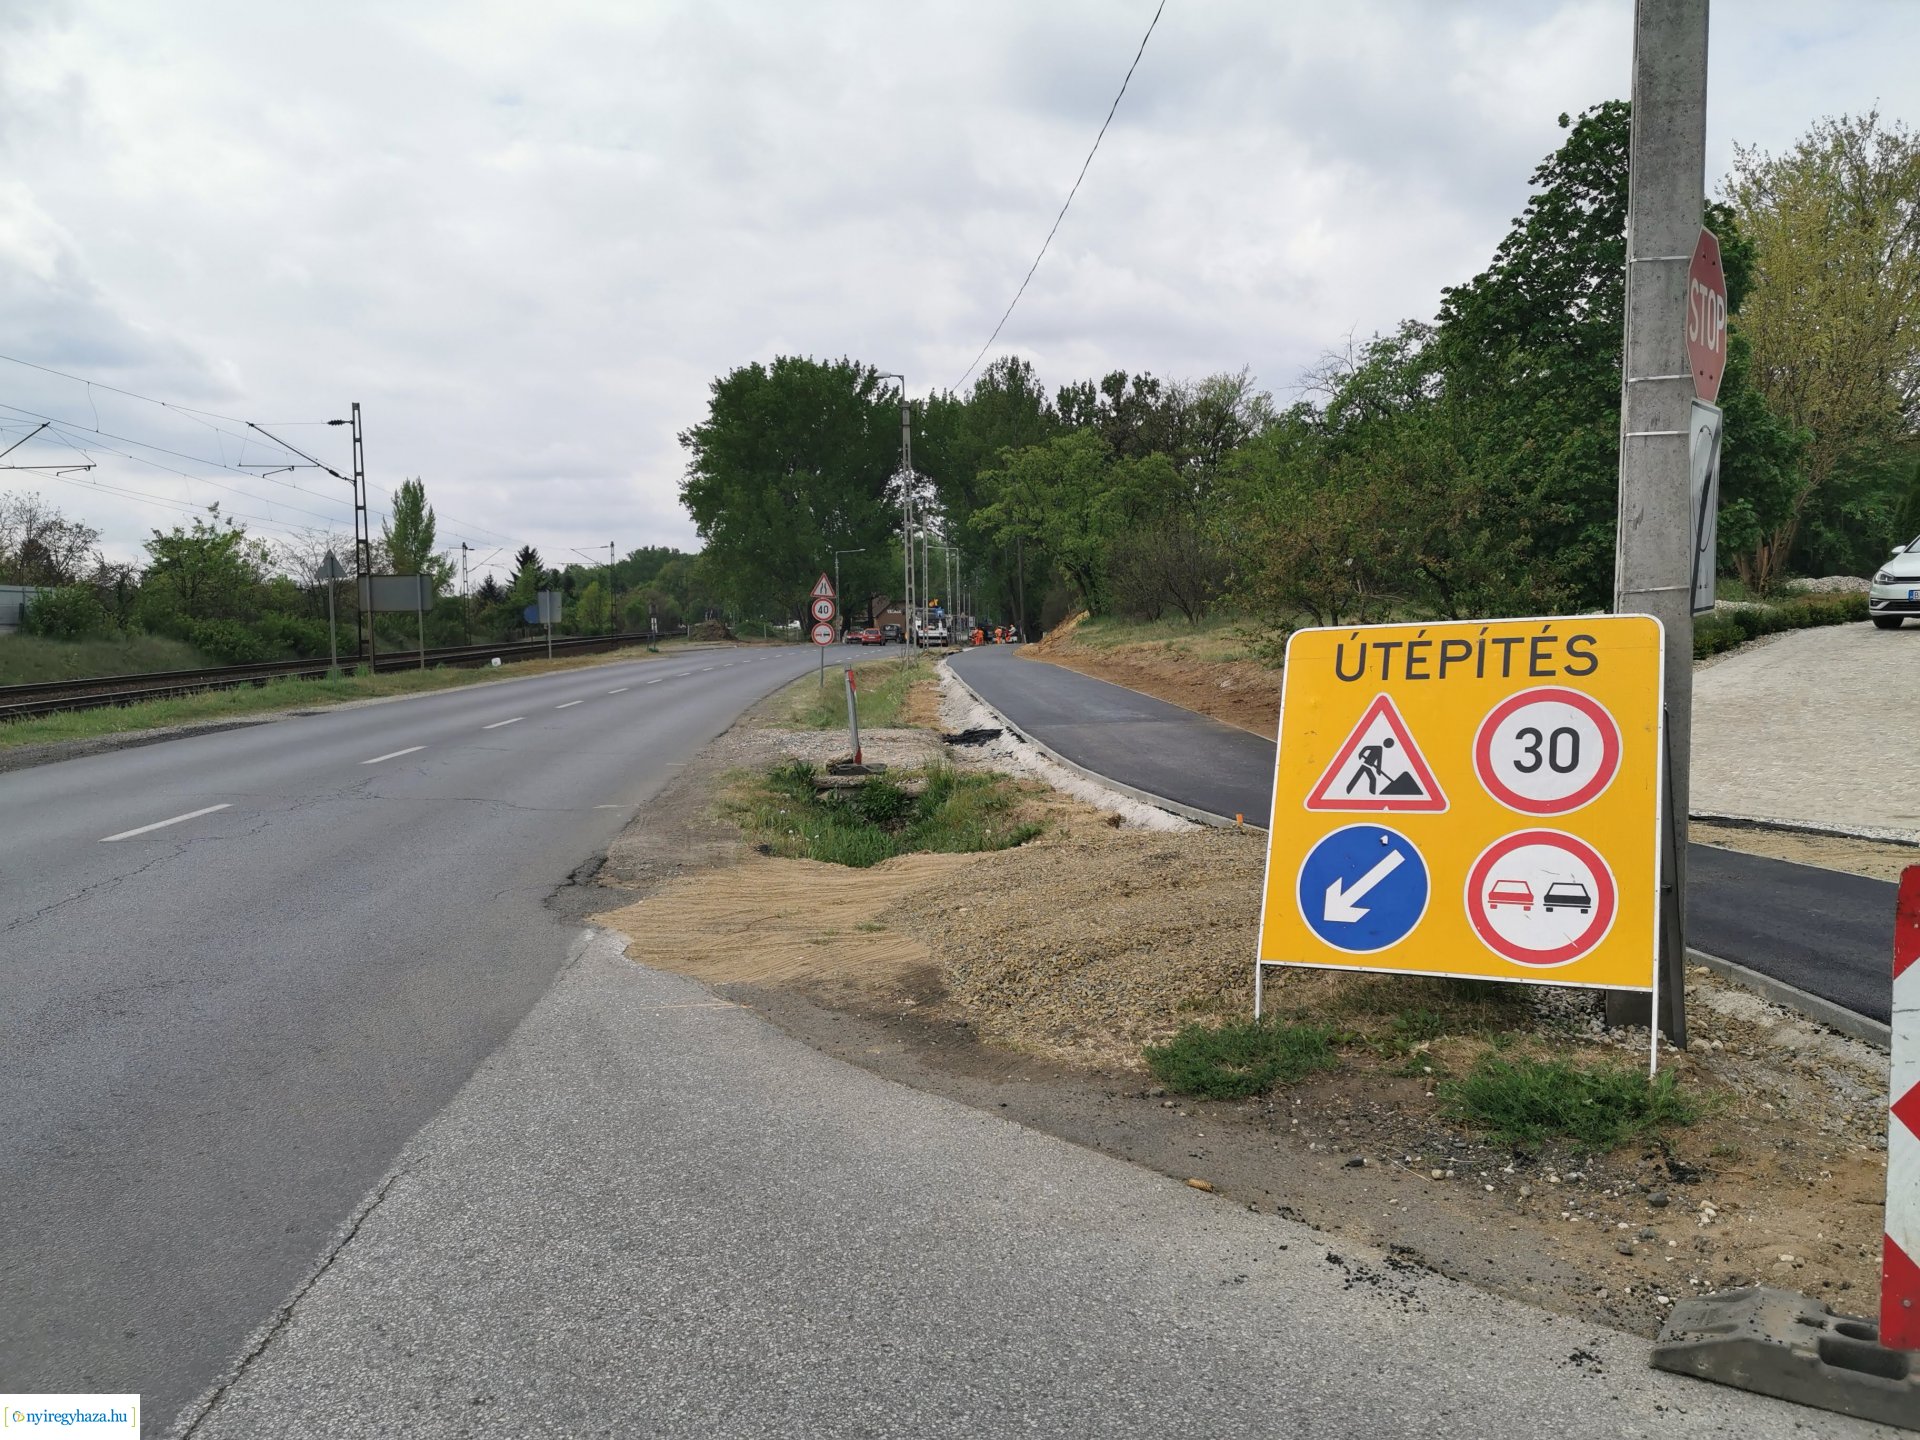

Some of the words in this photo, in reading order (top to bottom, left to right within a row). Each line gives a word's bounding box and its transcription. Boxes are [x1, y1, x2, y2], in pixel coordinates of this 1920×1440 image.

[1689, 278, 1724, 353] STOP
[818, 605, 828, 614] 40
[1335, 625, 1599, 682] ÚTÉPÍTÉS
[1513, 727, 1580, 773] 30
